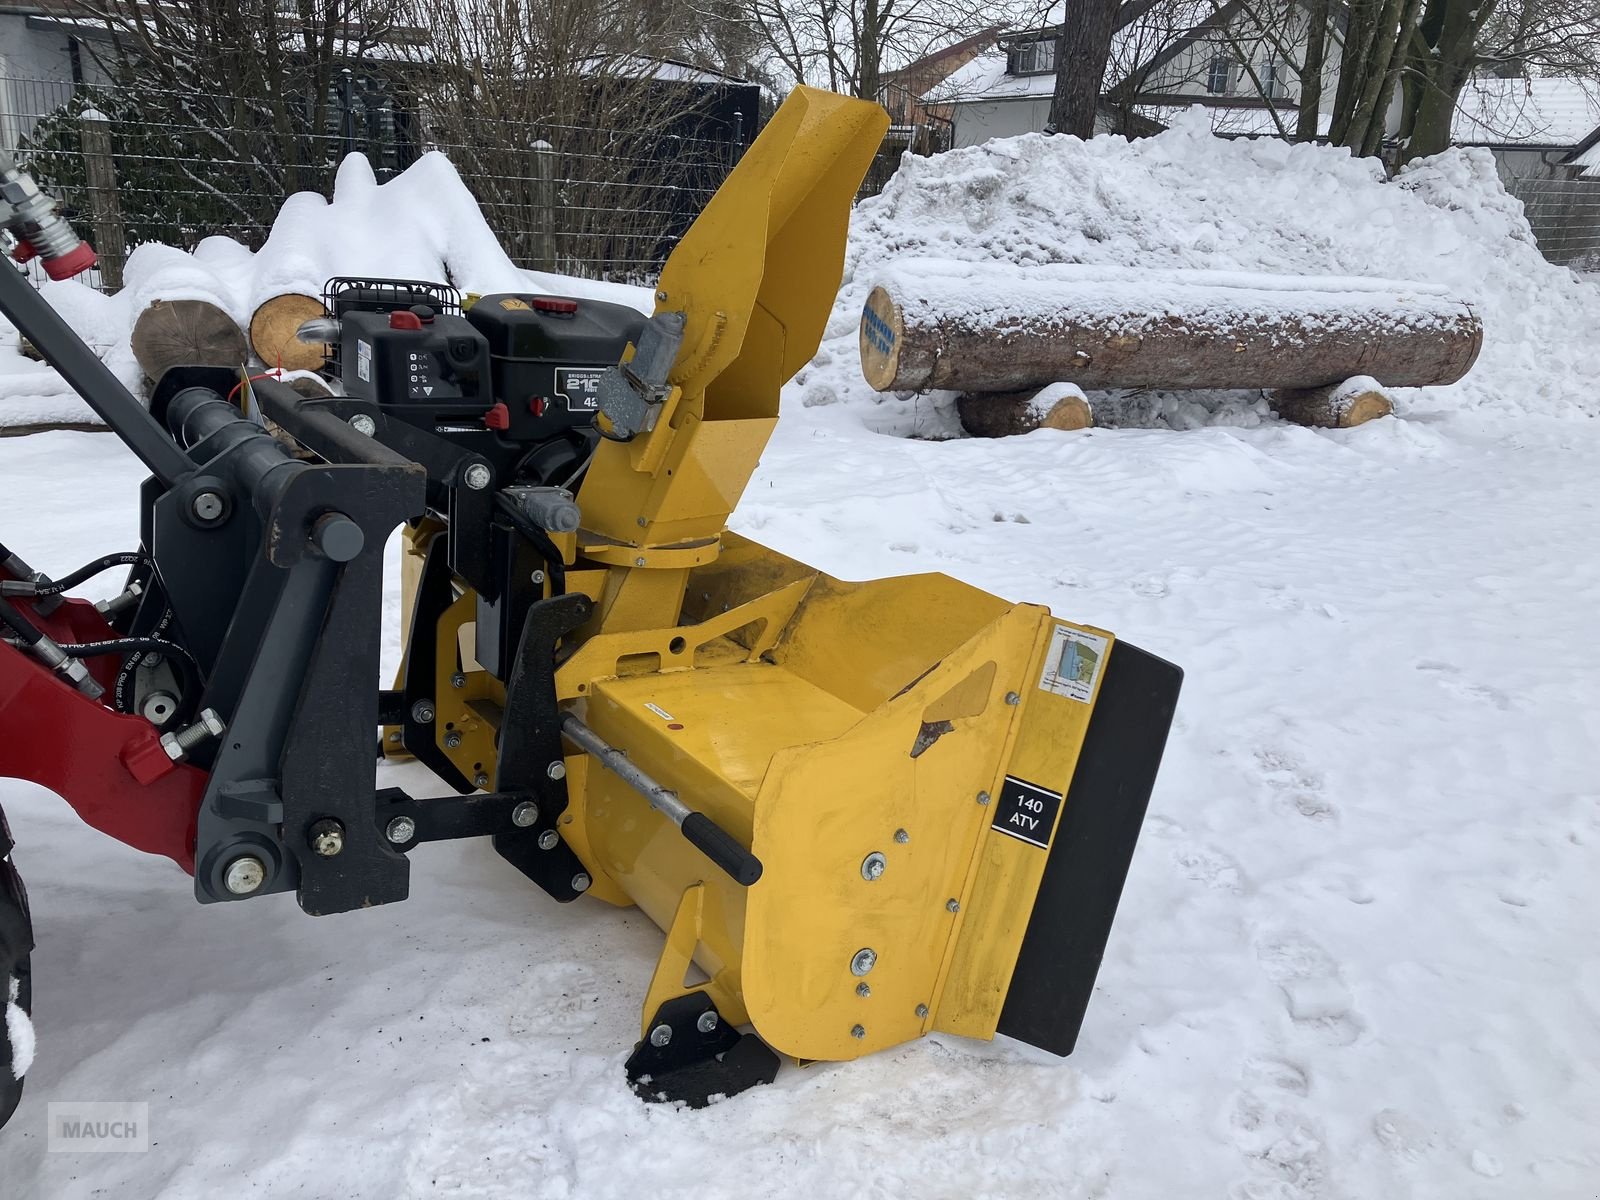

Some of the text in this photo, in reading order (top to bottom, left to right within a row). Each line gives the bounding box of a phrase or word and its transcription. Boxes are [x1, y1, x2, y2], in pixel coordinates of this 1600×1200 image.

[567, 379, 600, 389] 210
[584, 397, 598, 407] 42
[118, 672, 128, 686] PRO
[125, 660, 137, 671] EN
[131, 651, 142, 662] 857
[1017, 795, 1044, 813] 140
[1009, 812, 1040, 831] ATV
